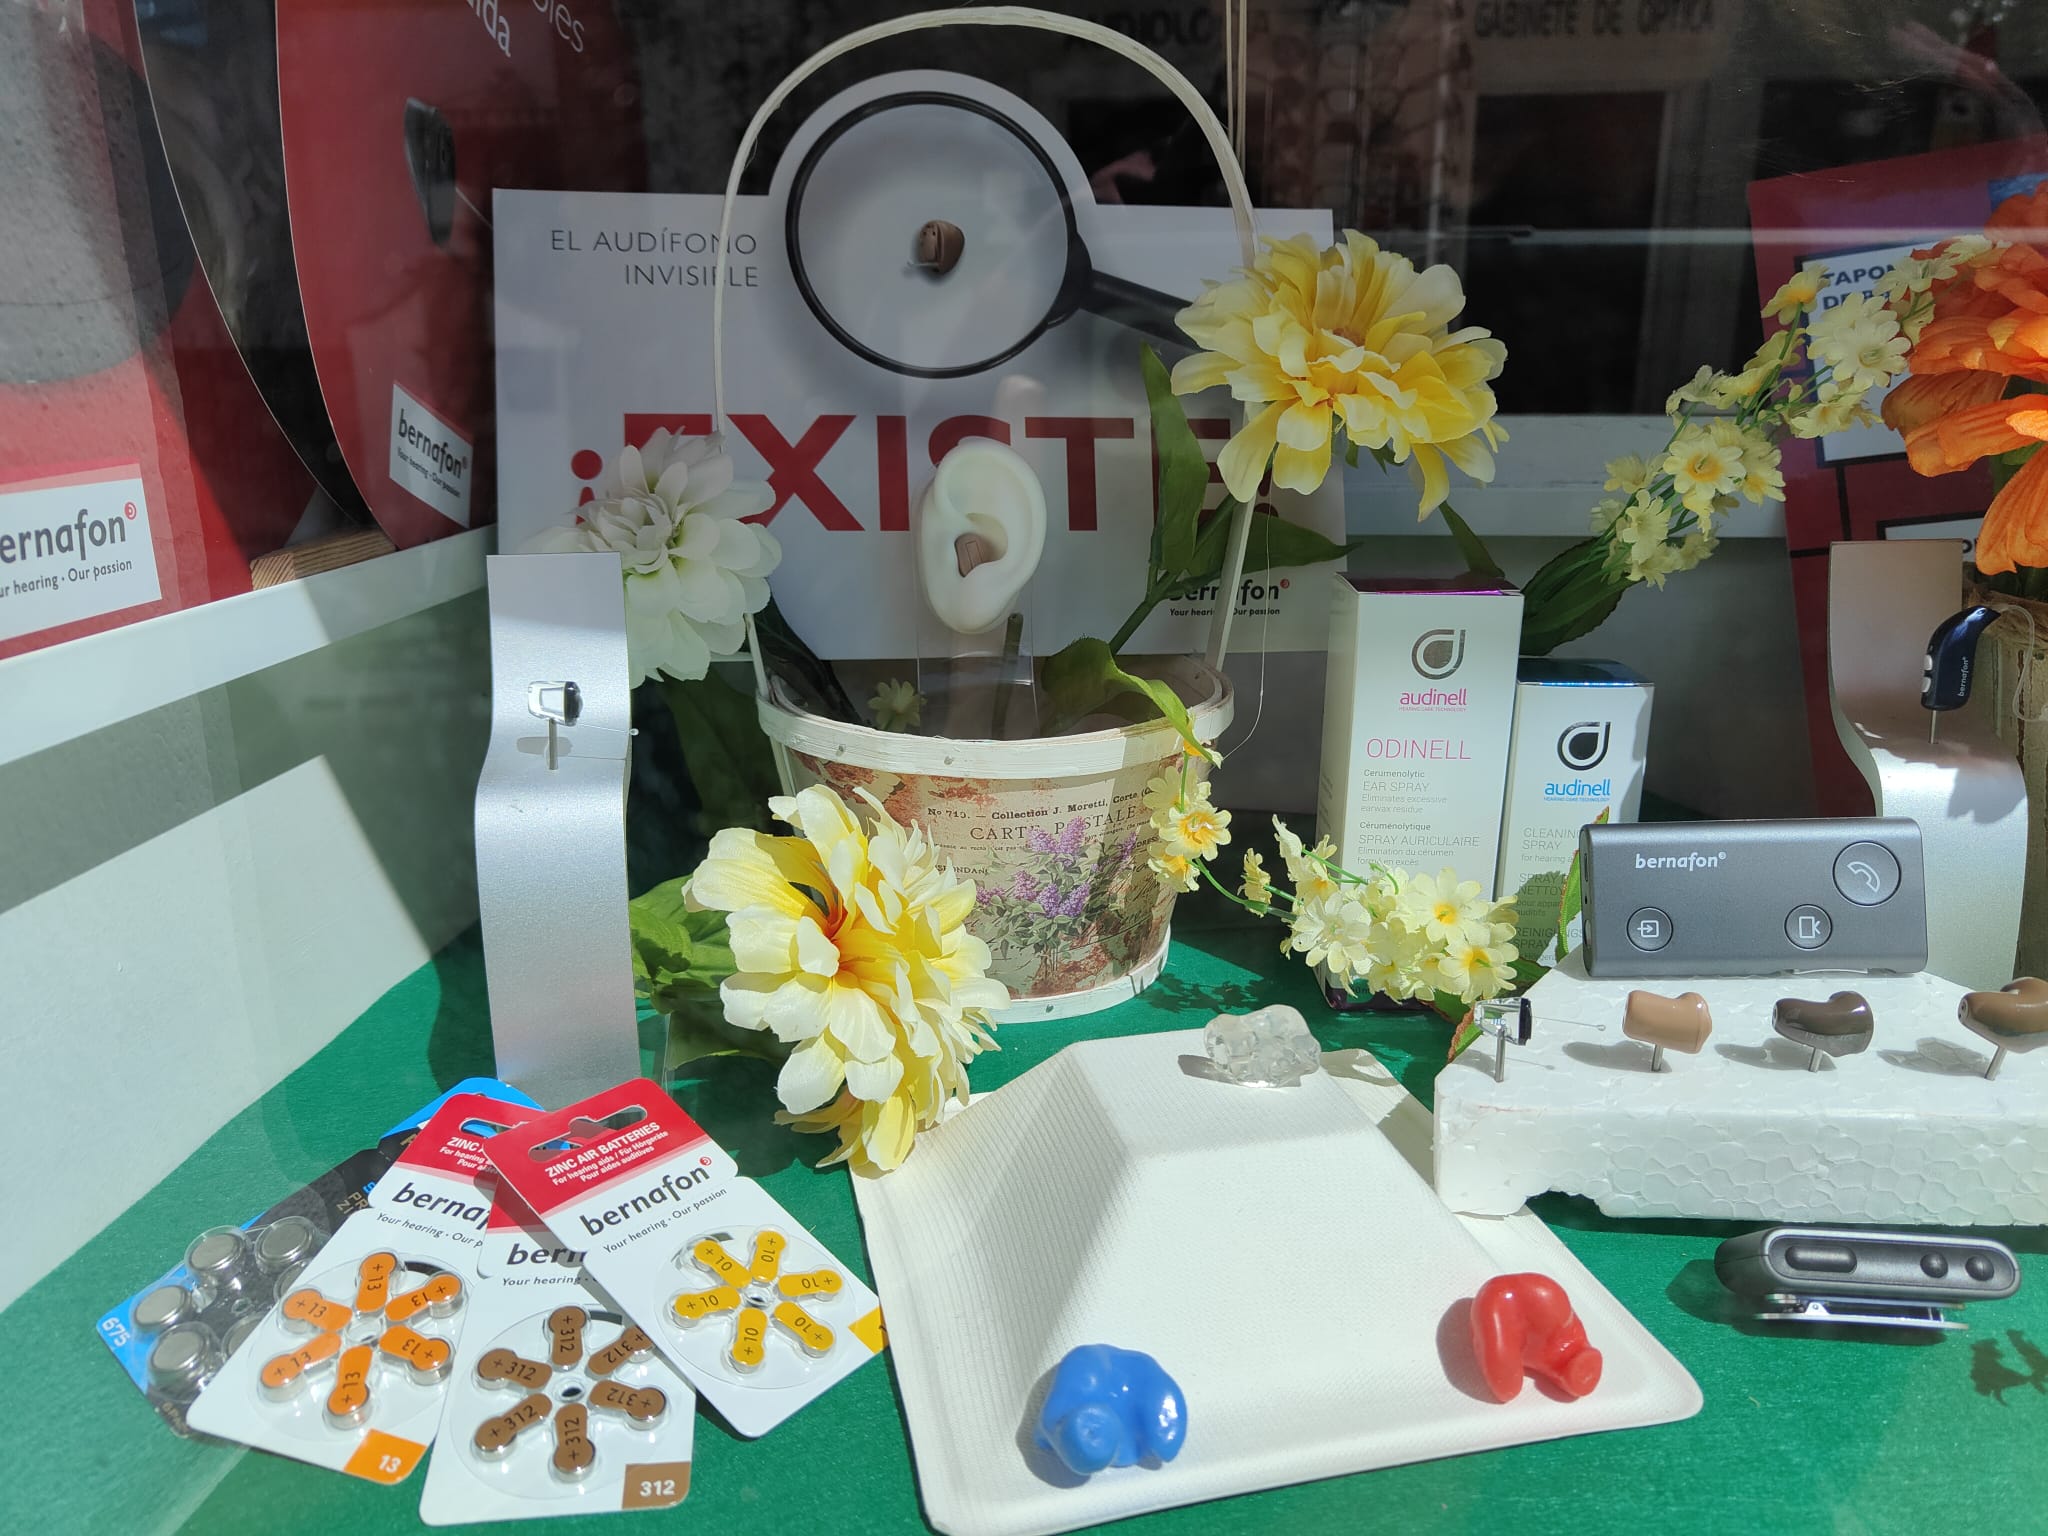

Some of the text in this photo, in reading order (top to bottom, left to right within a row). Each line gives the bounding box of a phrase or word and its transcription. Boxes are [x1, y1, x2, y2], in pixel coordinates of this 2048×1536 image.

[551, 229, 582, 251] EL
[398, 407, 462, 479] bernafon
[0, 508, 126, 563] ernafon
[13, 575, 59, 595] hearing
[68, 568, 90, 582] Our
[93, 560, 132, 581] passion
[1170, 608, 1188, 616] Your
[1190, 608, 1215, 616] heari
[1957, 660, 1969, 697] bernafon
[1400, 687, 1467, 706] audinell
[1366, 738, 1472, 760] ODINELL
[1363, 768, 1425, 779] Cerumenolytic
[1363, 781, 1430, 792] EAR SPRAY
[1545, 778, 1611, 797] audinell
[991, 809, 1049, 820] Collection
[1053, 806, 1062, 815] J.
[1067, 798, 1109, 813] Moretti,
[970, 824, 1040, 840] CART
[1054, 805, 1137, 835] PSTALE
[1359, 820, 1432, 832] Cérumenolytique
[1358, 834, 1481, 848] SPRAY AURICULAIRE
[1523, 828, 1580, 839] CLEANIN
[1406, 848, 1416, 857] du
[1522, 840, 1561, 850] SPRAY
[1635, 852, 1718, 871] bernafon
[447, 1137, 479, 1152] ZINC
[545, 1121, 660, 1178] ZINC AIR BATTERIES
[439, 1147, 455, 1155] For
[454, 1150, 485, 1164] hearing
[457, 1159, 477, 1169] Pour
[552, 1175, 567, 1186] For
[567, 1163, 599, 1180] hearing
[598, 1155, 614, 1165] aids
[619, 1146, 632, 1156] Für
[579, 1146, 655, 1182] Pour aides auditives
[392, 1182, 489, 1230] berna
[579, 1167, 710, 1236] bernafon
[377, 1212, 401, 1225] Your
[402, 1219, 443, 1238] hearing
[452, 1232, 473, 1246] Our
[603, 1188, 728, 1254] Your hearing Our passion
[506, 1243, 587, 1265] bern
[503, 1276, 581, 1286] Your hearing
[102, 1317, 131, 1347] 675
[378, 1454, 402, 1474] 13
[639, 1479, 676, 1497] 312
